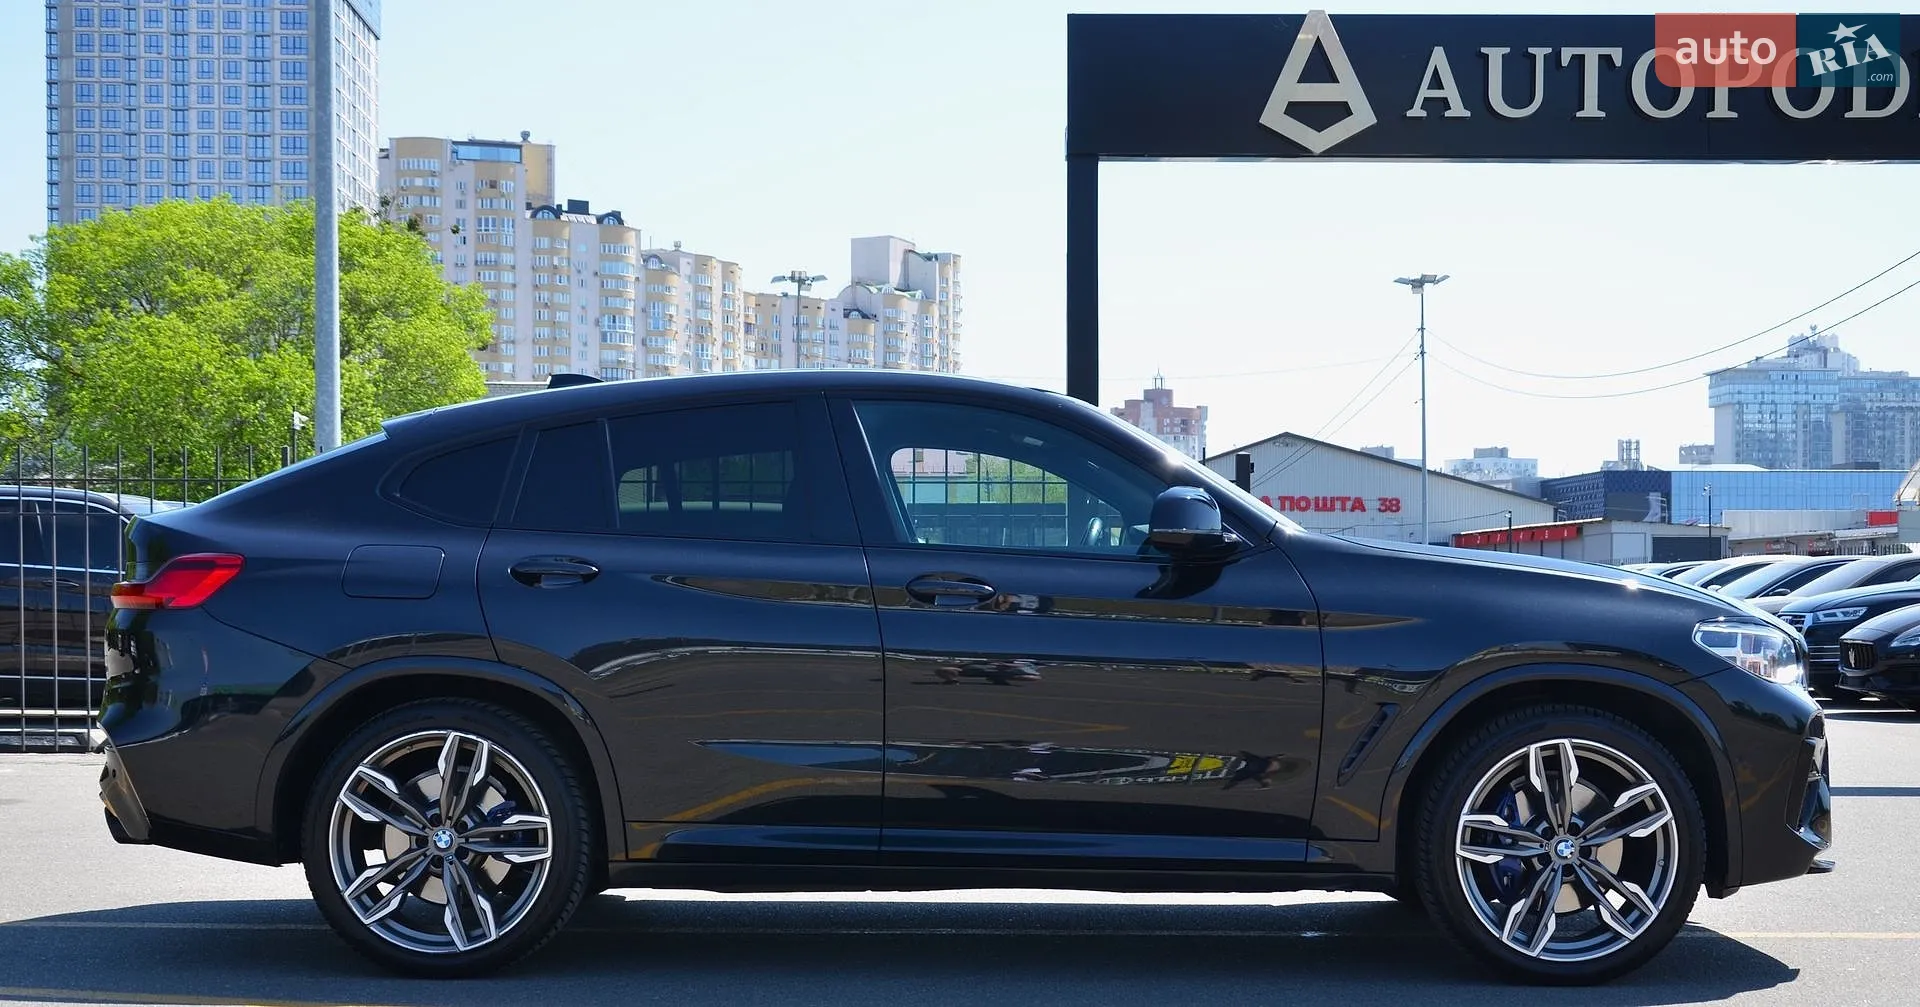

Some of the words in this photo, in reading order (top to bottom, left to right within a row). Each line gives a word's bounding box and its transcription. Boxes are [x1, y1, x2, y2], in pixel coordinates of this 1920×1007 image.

[1406, 46, 1920, 119] AUTOPOD
[1278, 496, 1367, 512] ПОШТА
[1378, 498, 1401, 513] 38
